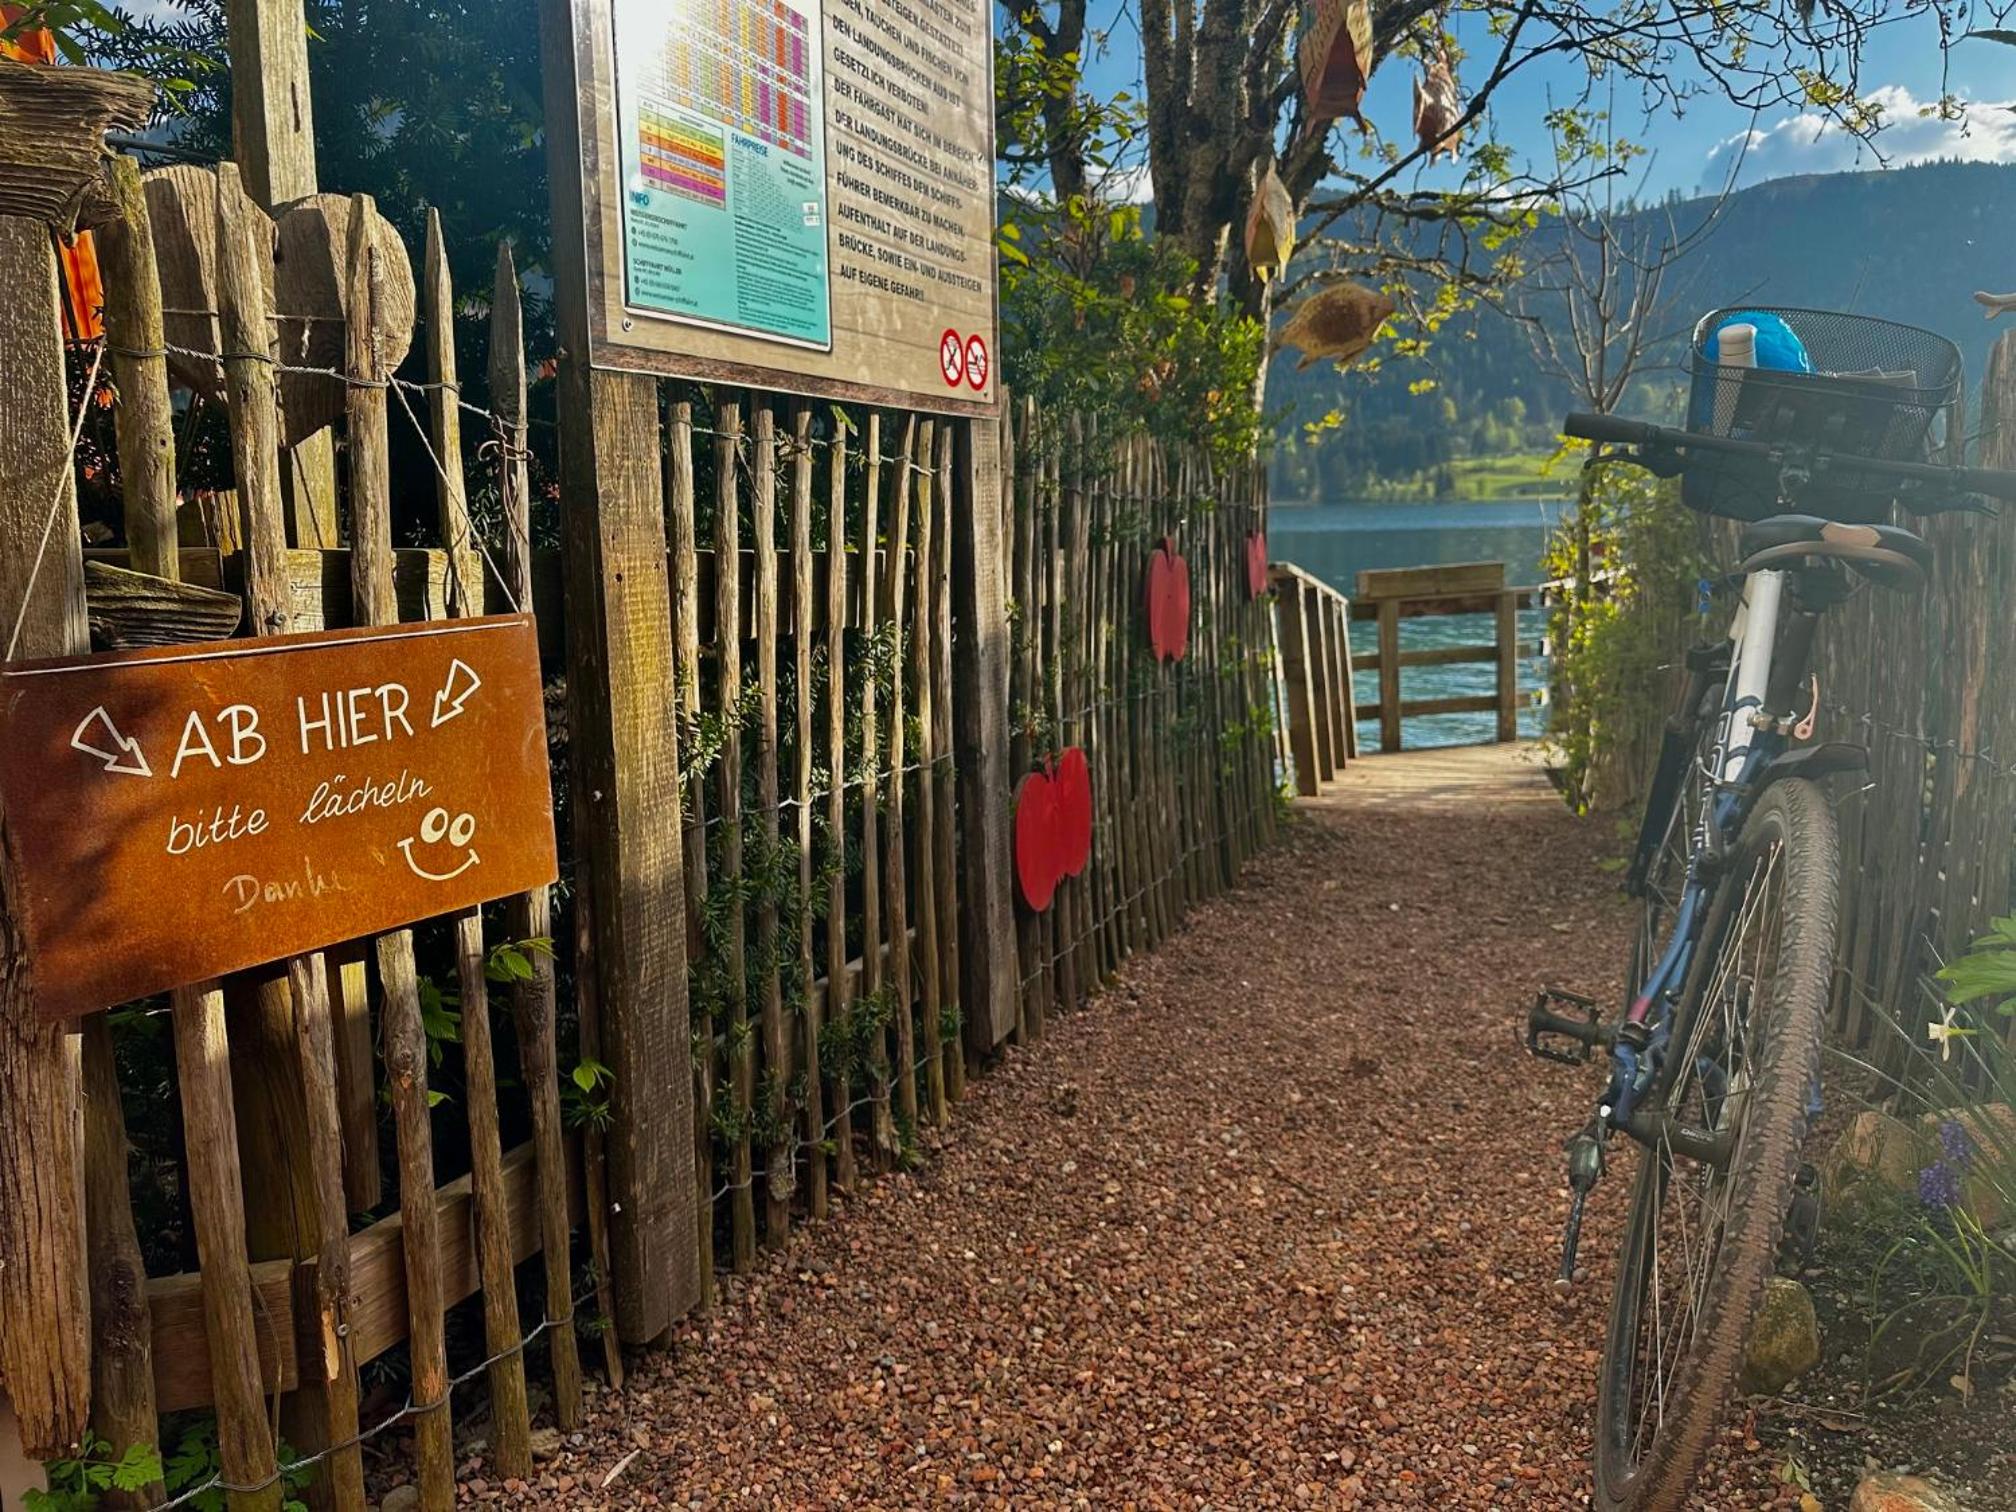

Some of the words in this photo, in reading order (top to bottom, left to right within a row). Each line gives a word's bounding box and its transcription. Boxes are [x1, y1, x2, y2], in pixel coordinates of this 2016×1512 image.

[832, 14, 851, 39] DEN
[852, 28, 931, 91] LANDUNGSBRÜCKEN
[933, 83, 947, 101] AUS
[833, 47, 885, 90] GESETZLICH
[865, 6, 902, 44] TAUCHEN
[903, 34, 920, 56] UND
[921, 46, 952, 77] FISCHEN
[834, 78, 851, 99] DER
[854, 89, 895, 124] FAHRGAST
[897, 115, 912, 134] HAT
[913, 123, 931, 144] SICH
[943, 138, 974, 166] BEREICH
[835, 109, 853, 131] DER
[854, 119, 928, 169] LANDUNGSBRÜCKE
[929, 160, 941, 175] BEI
[836, 140, 855, 161] UNG
[857, 153, 873, 169] DES
[875, 160, 912, 188] SCHIFFES
[913, 178, 929, 197] DEM
[931, 186, 963, 210] SCHIFFS-
[836, 171, 871, 199] FÜHRER
[873, 188, 921, 219] BEMERKBAR
[922, 210, 932, 225] ZU
[838, 202, 891, 235] AUFENTHALT
[893, 225, 908, 242] AUF
[909, 232, 925, 249] DER
[926, 239, 967, 263] LANDUNGS-
[838, 233, 876, 262] BRÜCKE,
[877, 248, 902, 268] SOWIE
[920, 264, 937, 279] UND
[938, 269, 982, 294] AUSSTEIGEN
[840, 264, 857, 281] AUF
[859, 270, 889, 292] EIGENE
[170, 704, 267, 778] AB
[297, 683, 415, 754] HIER
[166, 804, 270, 855] bitte
[299, 768, 434, 824] lächeln
